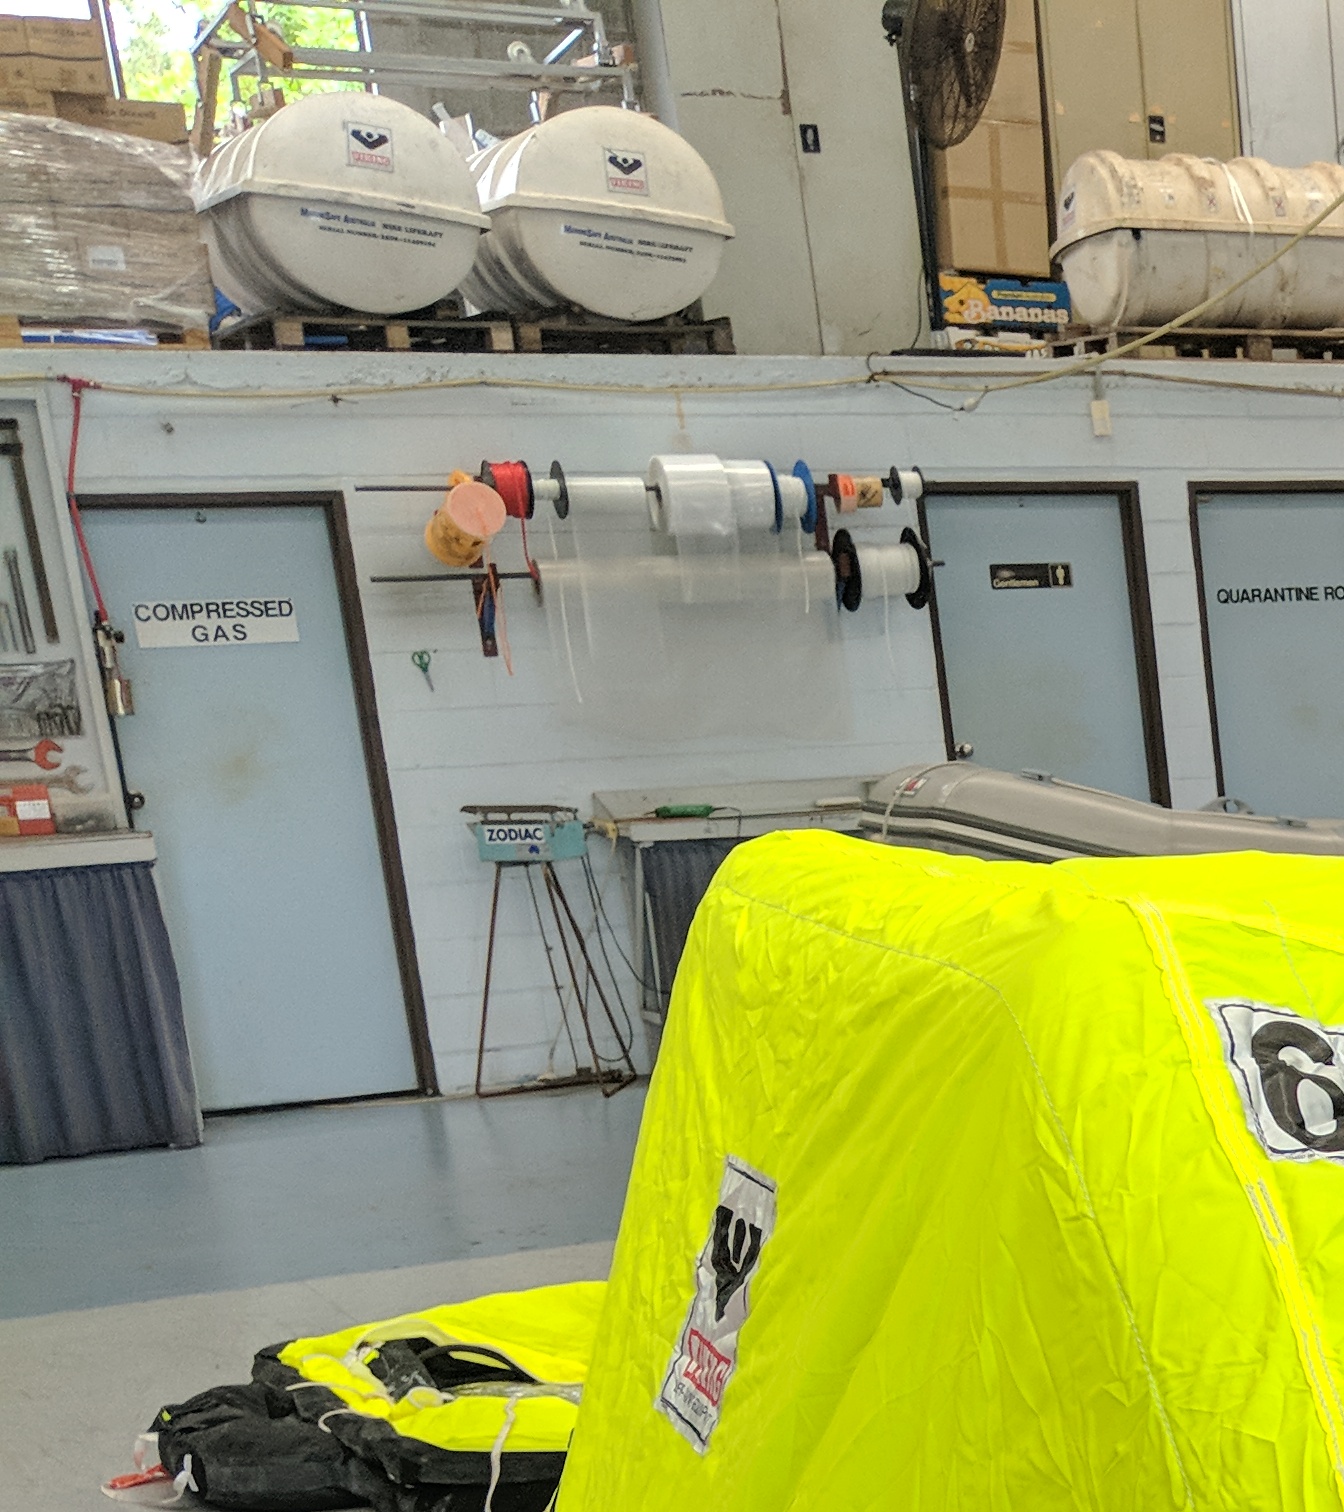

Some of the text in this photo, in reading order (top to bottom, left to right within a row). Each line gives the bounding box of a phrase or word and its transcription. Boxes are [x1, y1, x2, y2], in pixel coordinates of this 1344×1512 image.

[963, 300, 1069, 323] Bananas
[1217, 586, 1320, 604] QUARANTINE
[134, 600, 294, 622] COMPRESSED
[191, 623, 248, 643] GAS
[486, 827, 543, 842] ZODIAC
